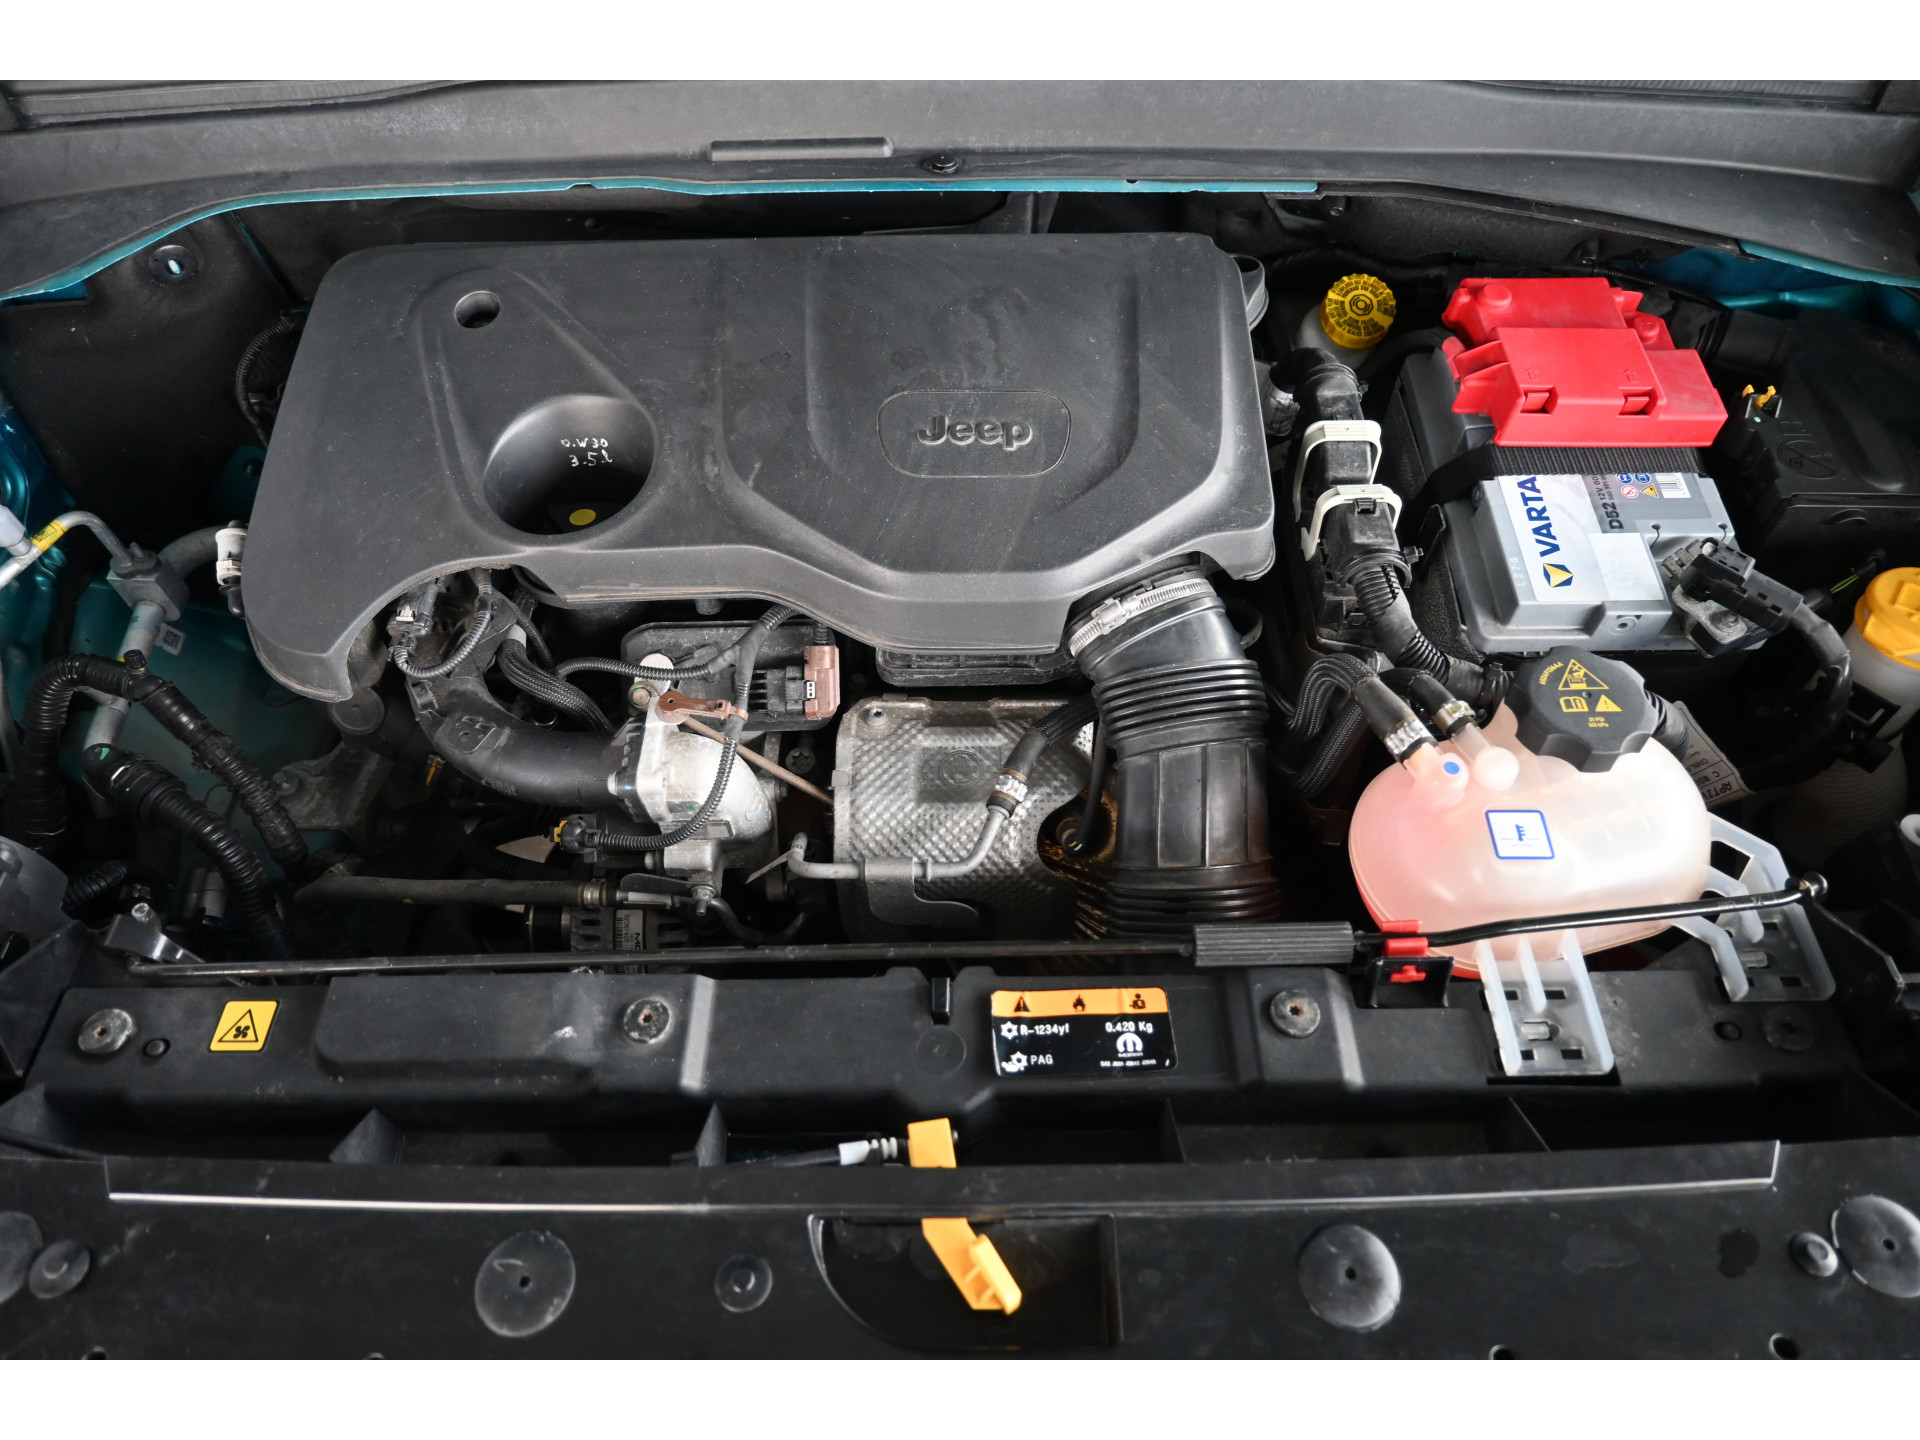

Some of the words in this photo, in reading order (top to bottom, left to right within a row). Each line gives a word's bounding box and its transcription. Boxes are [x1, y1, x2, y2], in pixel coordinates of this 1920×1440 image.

[917, 415, 1032, 451] Jeep
[1517, 476, 1560, 557] VARTA
[1602, 501, 1624, 529] D52
[1020, 1023, 1069, 1036] R-1234yf
[1105, 1021, 1135, 1032] 0.420
[1138, 1021, 1153, 1034] Kg
[1030, 1054, 1053, 1065] PAG
